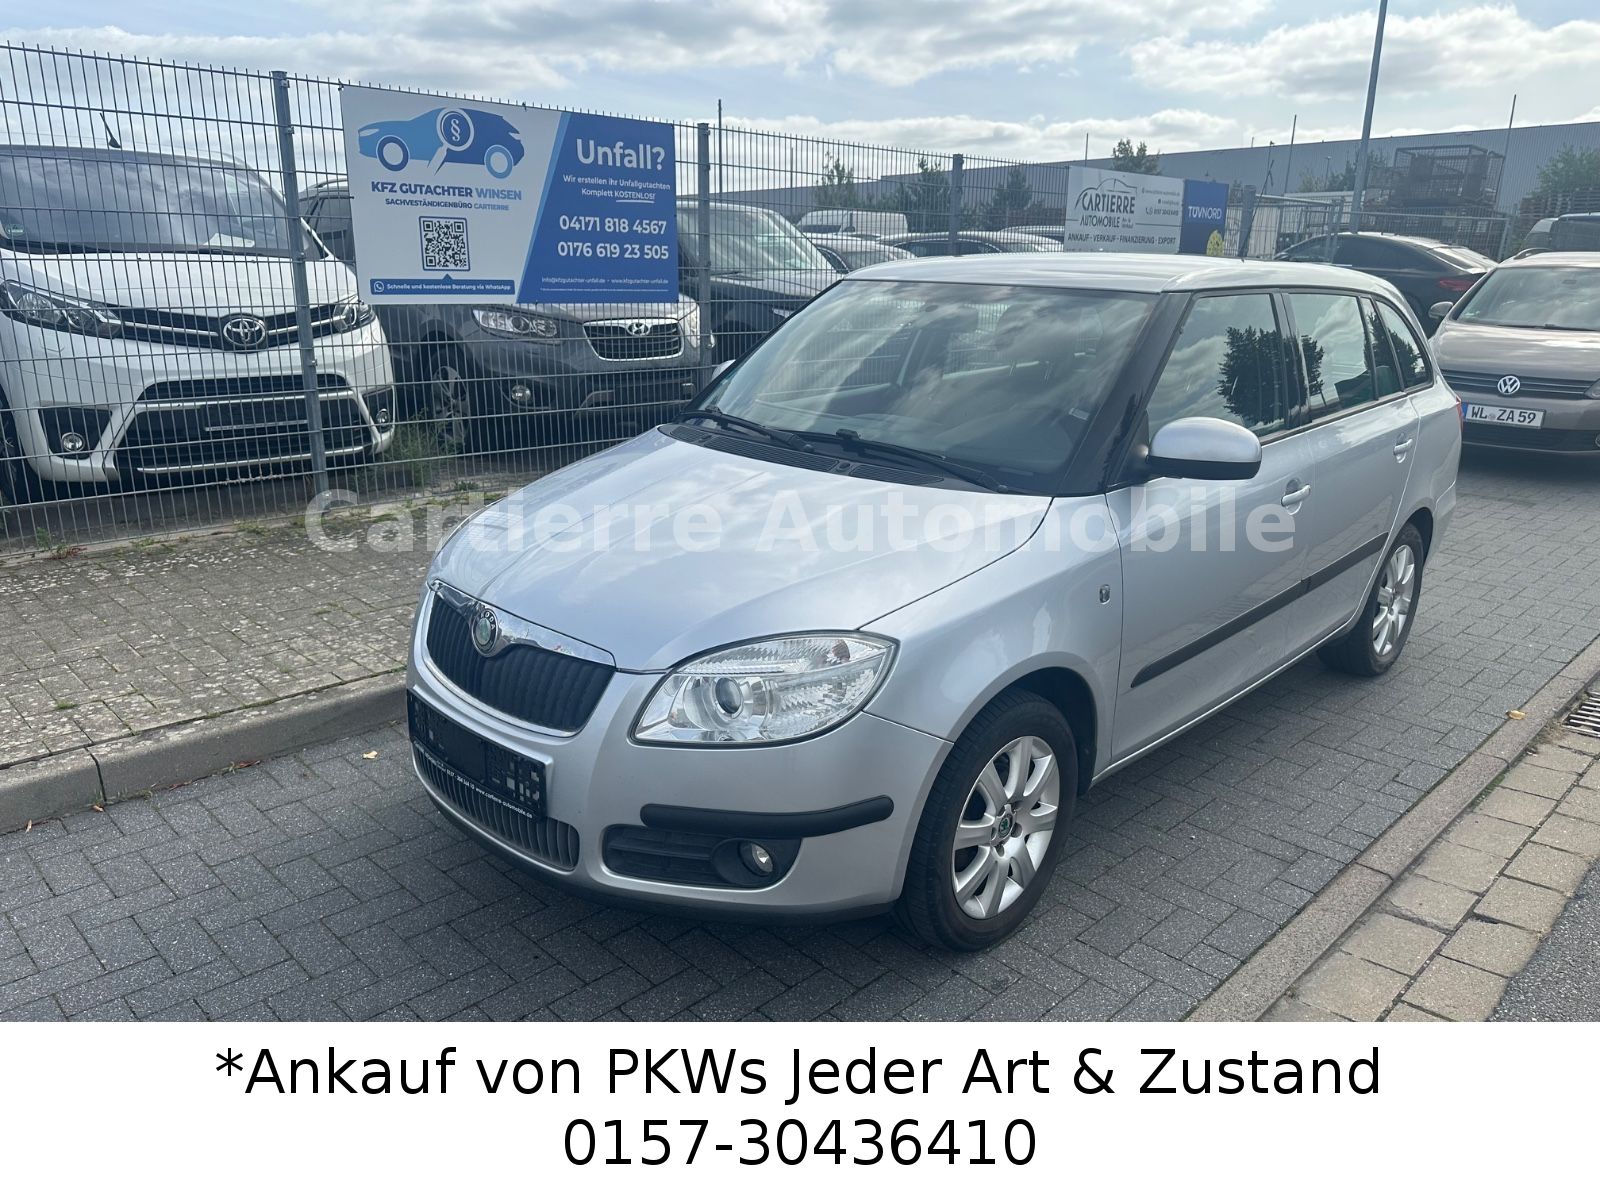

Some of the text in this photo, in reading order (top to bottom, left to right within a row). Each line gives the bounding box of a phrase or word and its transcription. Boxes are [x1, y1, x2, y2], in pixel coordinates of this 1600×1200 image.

[576, 138, 665, 171] Unfall?
[371, 181, 522, 200] KFZ GUTACHTER WINSEN
[562, 174, 671, 190] Wir erstellen ihr Unfallgutachten
[581, 188, 613, 198] Komplett
[1081, 192, 1136, 214] CARTIERRE
[559, 215, 667, 235] 04171 818 4567
[1080, 214, 1120, 228] AUTOMOBILE
[1068, 233, 1176, 245] ANKAUF VERKAUF FINANZIERUNG EXPORT
[557, 241, 669, 260] 0176 619 23 505
[1471, 406, 1536, 424] WL ZA 59
